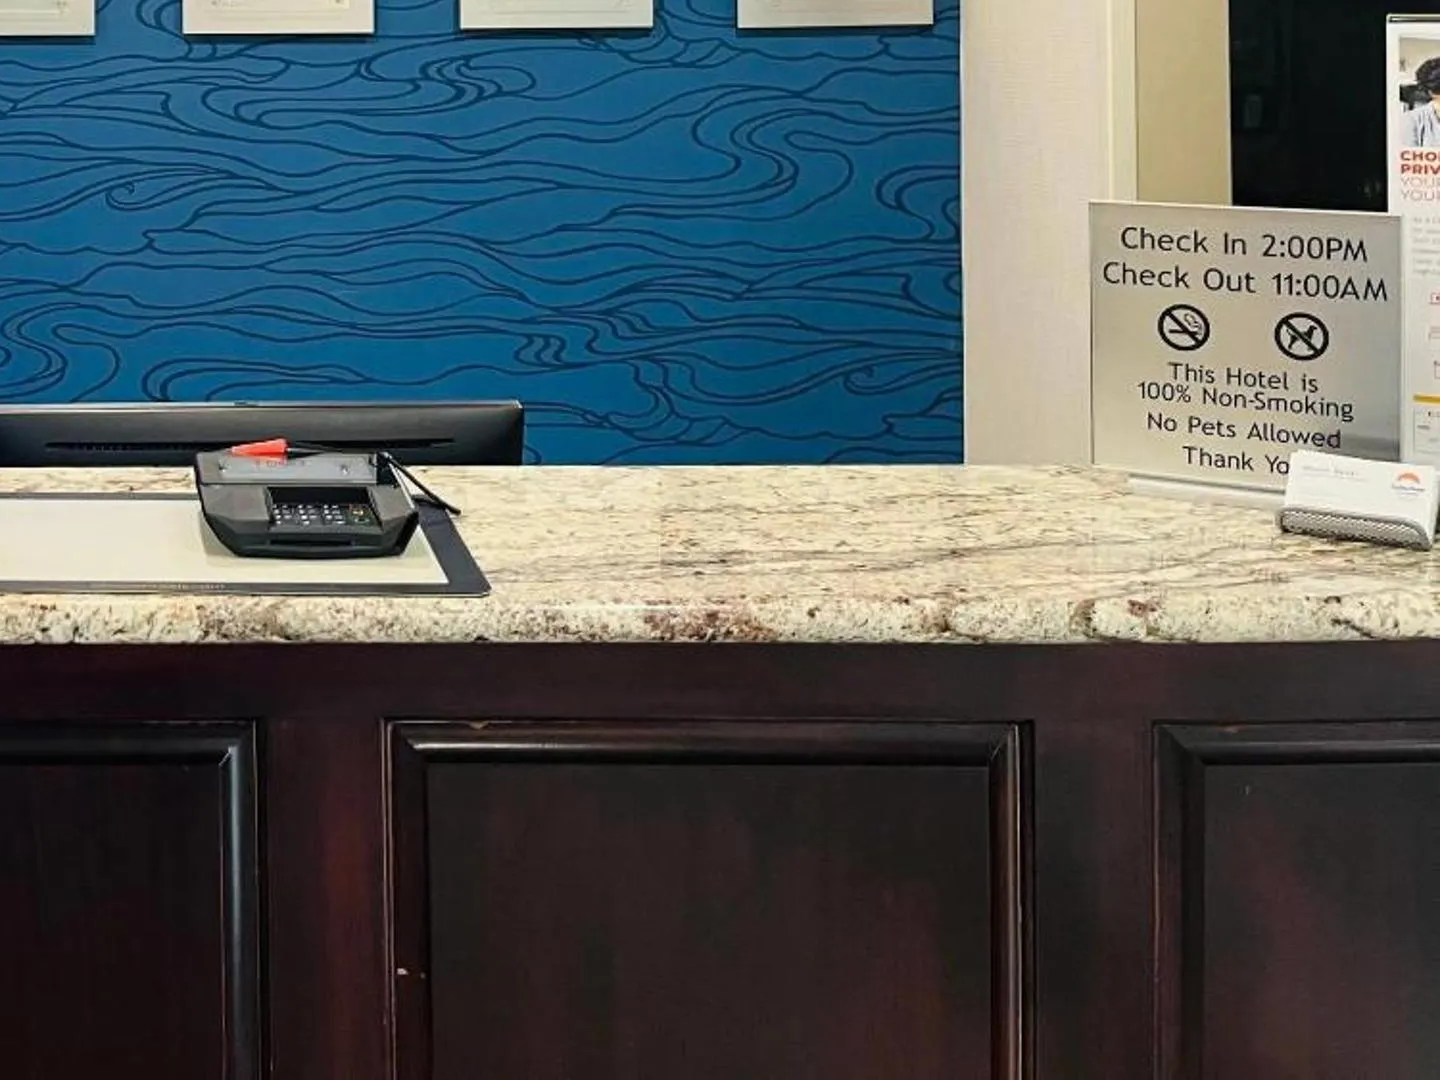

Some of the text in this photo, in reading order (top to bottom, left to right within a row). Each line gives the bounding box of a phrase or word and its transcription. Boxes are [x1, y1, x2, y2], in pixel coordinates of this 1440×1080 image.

[1120, 226, 1368, 262] Check In 2:00PM
[1103, 262, 1388, 302] Check Out 11:00AM
[1168, 361, 1318, 393] This Hotel is
[1137, 381, 1355, 422] 100% Non-Smoking
[1147, 413, 1341, 449] No Pets Allowed
[1182, 446, 1255, 472] Thank
[1264, 455, 1290, 475] Yo
